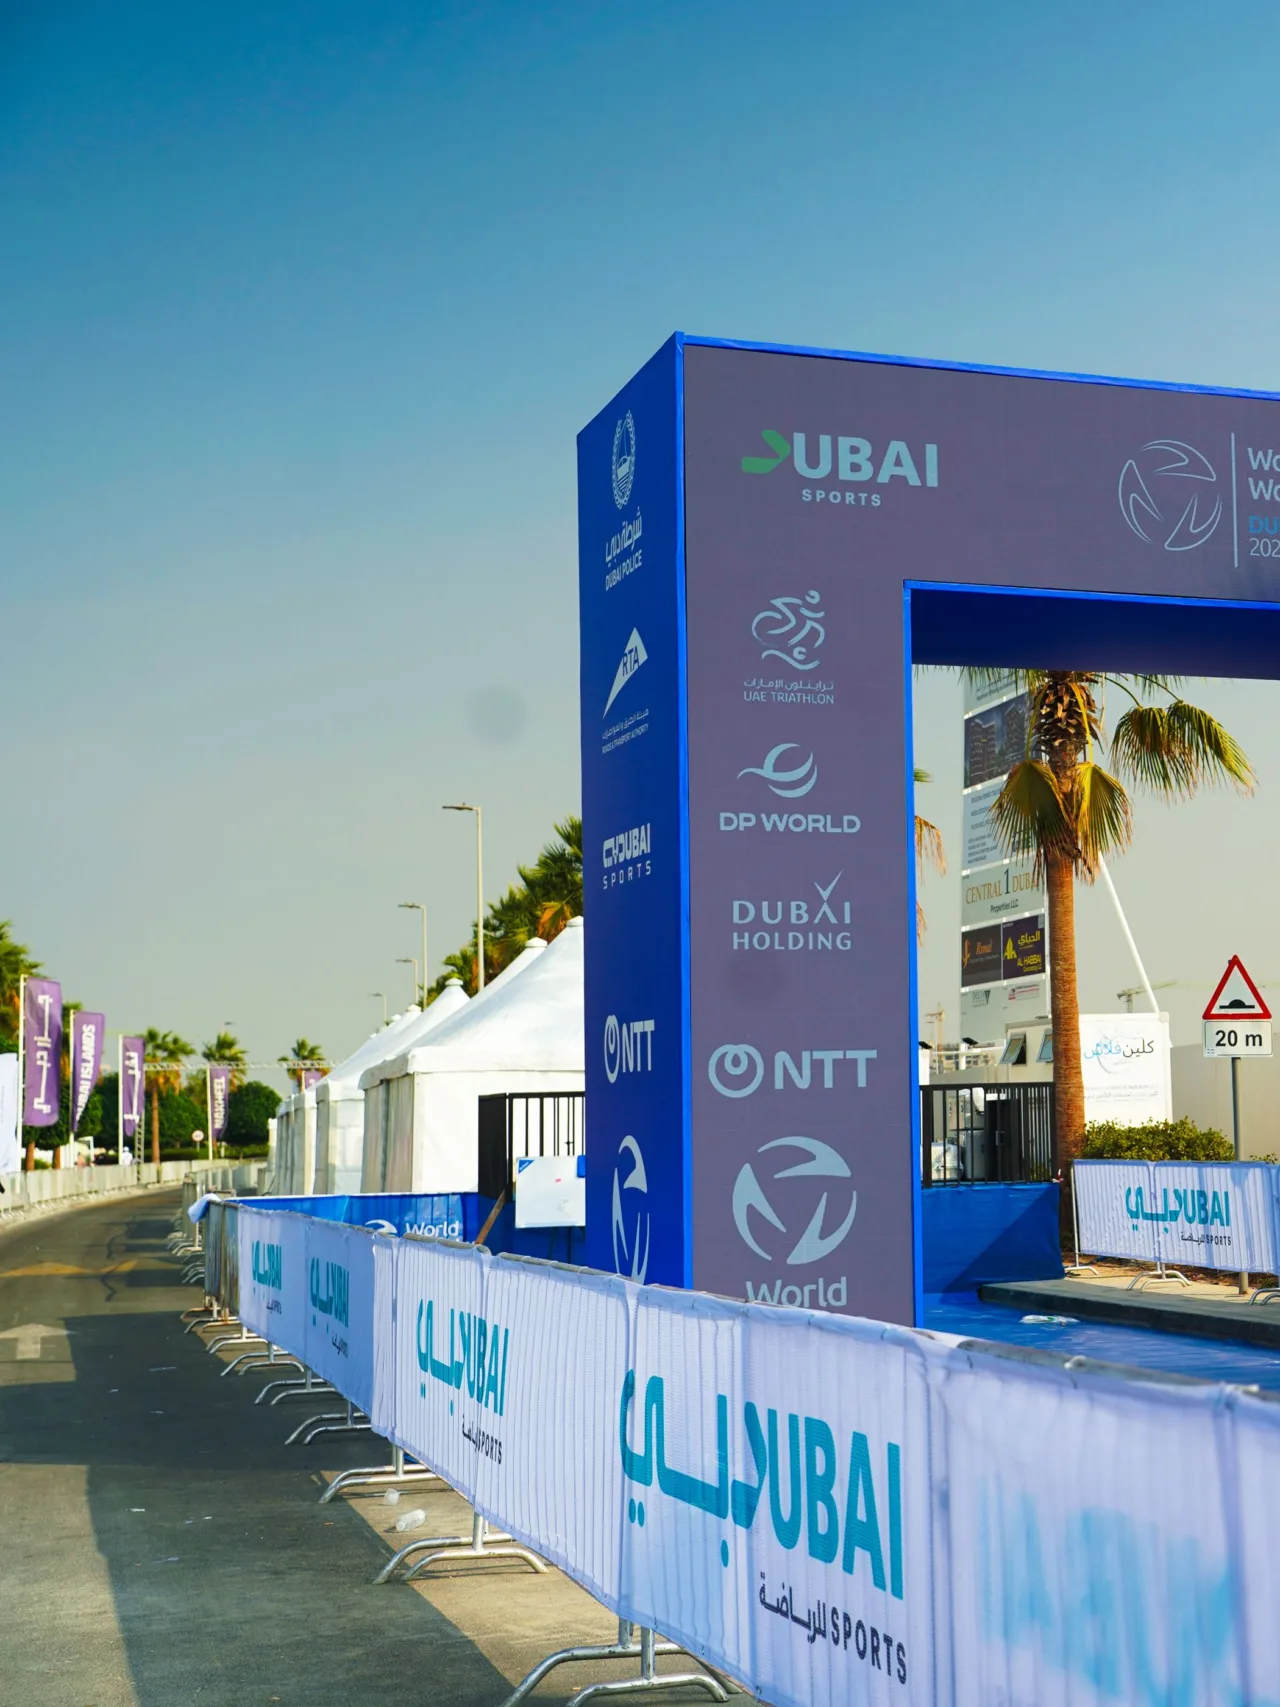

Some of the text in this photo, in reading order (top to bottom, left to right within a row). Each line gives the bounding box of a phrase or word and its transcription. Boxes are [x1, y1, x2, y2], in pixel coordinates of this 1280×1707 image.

[802, 489, 882, 506] SPORTS
[606, 549, 642, 592] DUBAI POLICE
[622, 646, 640, 677] RTA
[743, 690, 835, 705] UAE TRIATHLON
[719, 812, 861, 833] DP WORLD
[603, 860, 651, 889] SPORTS
[966, 880, 1002, 904] CENTRAL
[1004, 868, 1010, 894] 1
[733, 901, 851, 924] DUBAI
[990, 899, 1019, 914] Properties LLC
[733, 931, 851, 951] HOLDING
[82, 1024, 96, 1080] ISLANDS
[622, 1019, 655, 1073] NTT
[1215, 1030, 1263, 1047] 20 m
[774, 1050, 877, 1090] NTT
[405, 1220, 460, 1237] World
[1205, 1232, 1232, 1246] SPORTS
[745, 1276, 847, 1308] World
[477, 1427, 503, 1465] SPORTS
[731, 1401, 904, 1601] DUBAI
[831, 1605, 907, 1685] SPORTS
